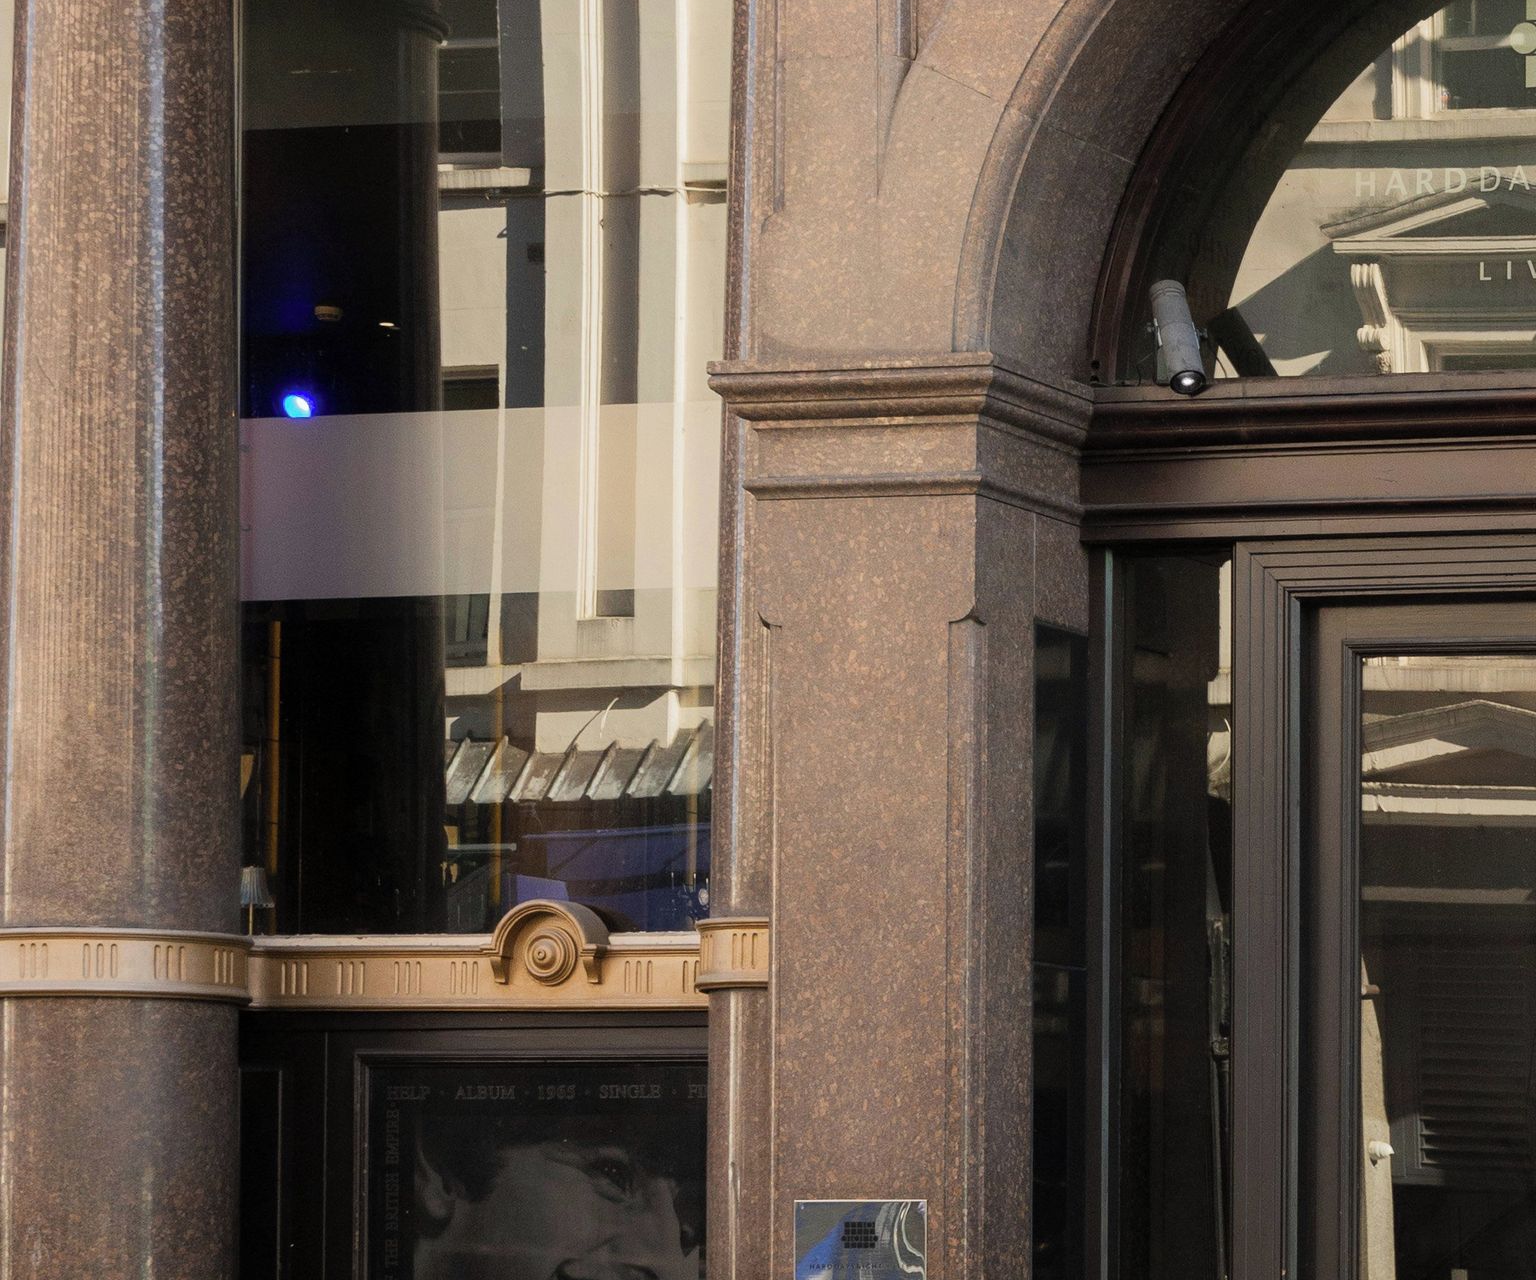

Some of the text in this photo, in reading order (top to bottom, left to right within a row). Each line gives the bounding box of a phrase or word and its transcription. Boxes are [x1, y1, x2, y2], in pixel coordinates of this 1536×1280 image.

[455, 1083, 516, 1100] ALBUM
[537, 1083, 577, 1100] 1965
[599, 1083, 662, 1100] SINGLE
